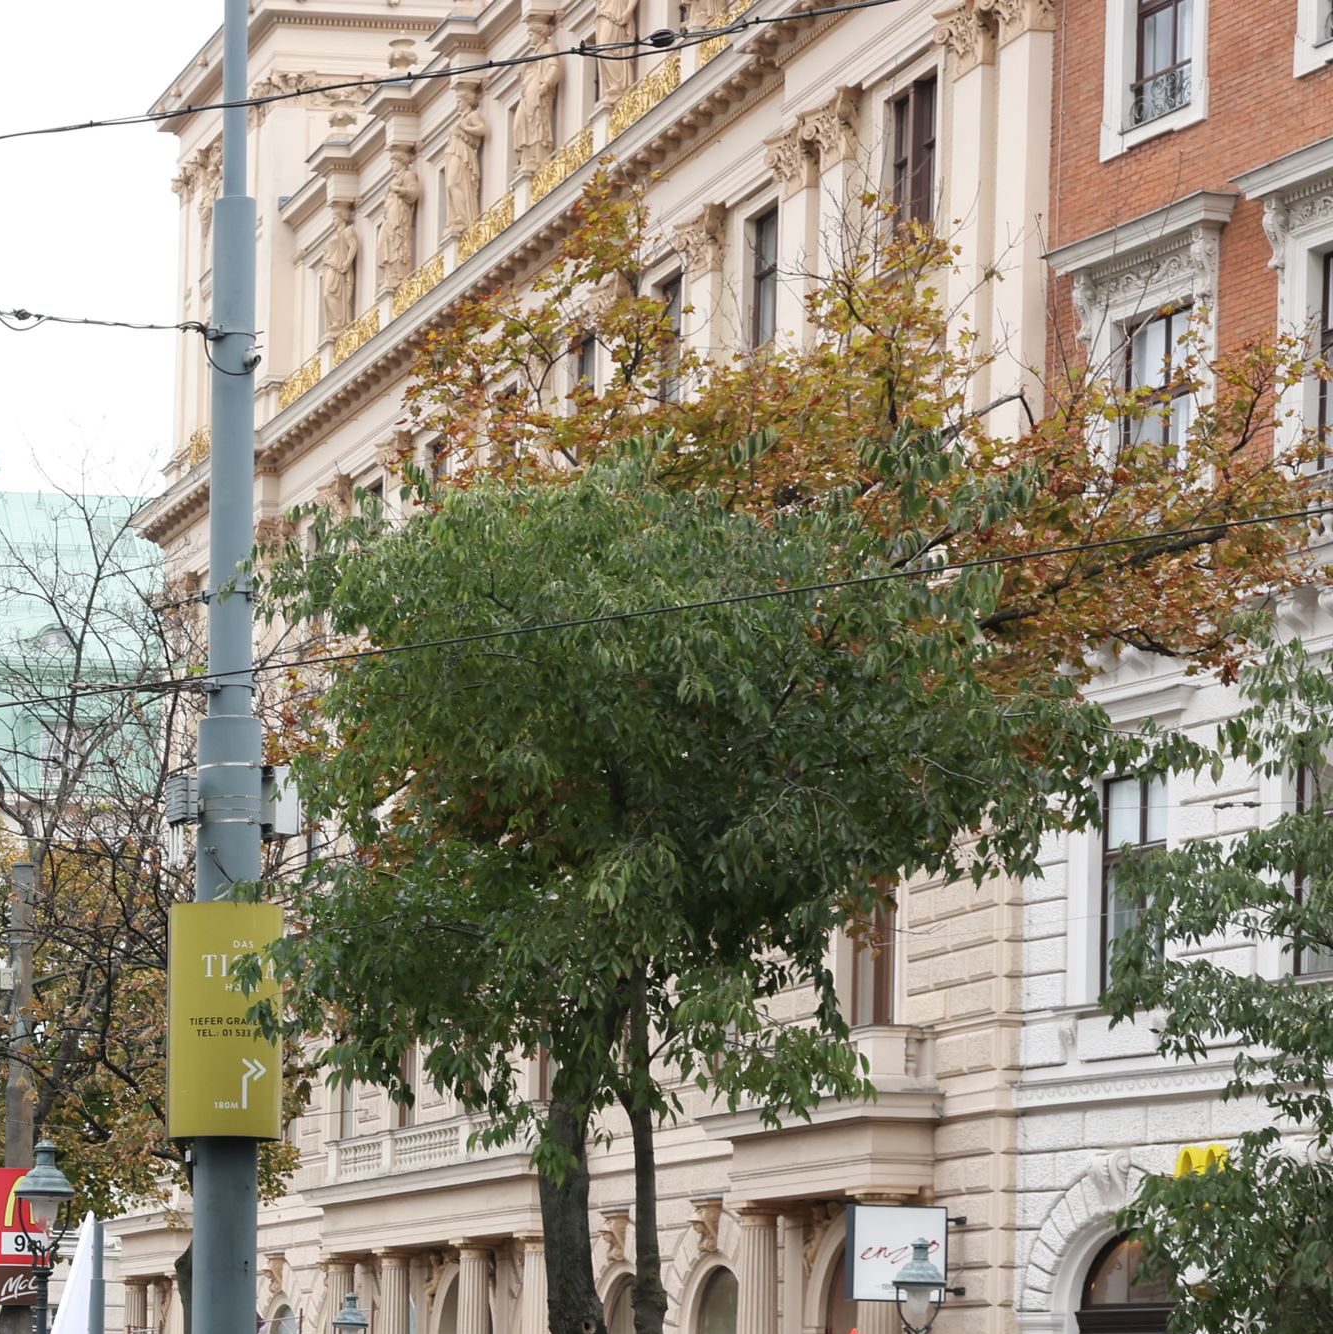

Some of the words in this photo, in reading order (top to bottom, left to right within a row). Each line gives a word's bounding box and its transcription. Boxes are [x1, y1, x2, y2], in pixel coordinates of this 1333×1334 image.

[232, 940, 254, 949] DAS
[190, 1017, 223, 1026] TIEFER
[197, 1028, 219, 1037] TEL.:
[222, 1028, 233, 1037] 01
[235, 1028, 251, 1037] 533
[214, 1101, 239, 1110] 180M
